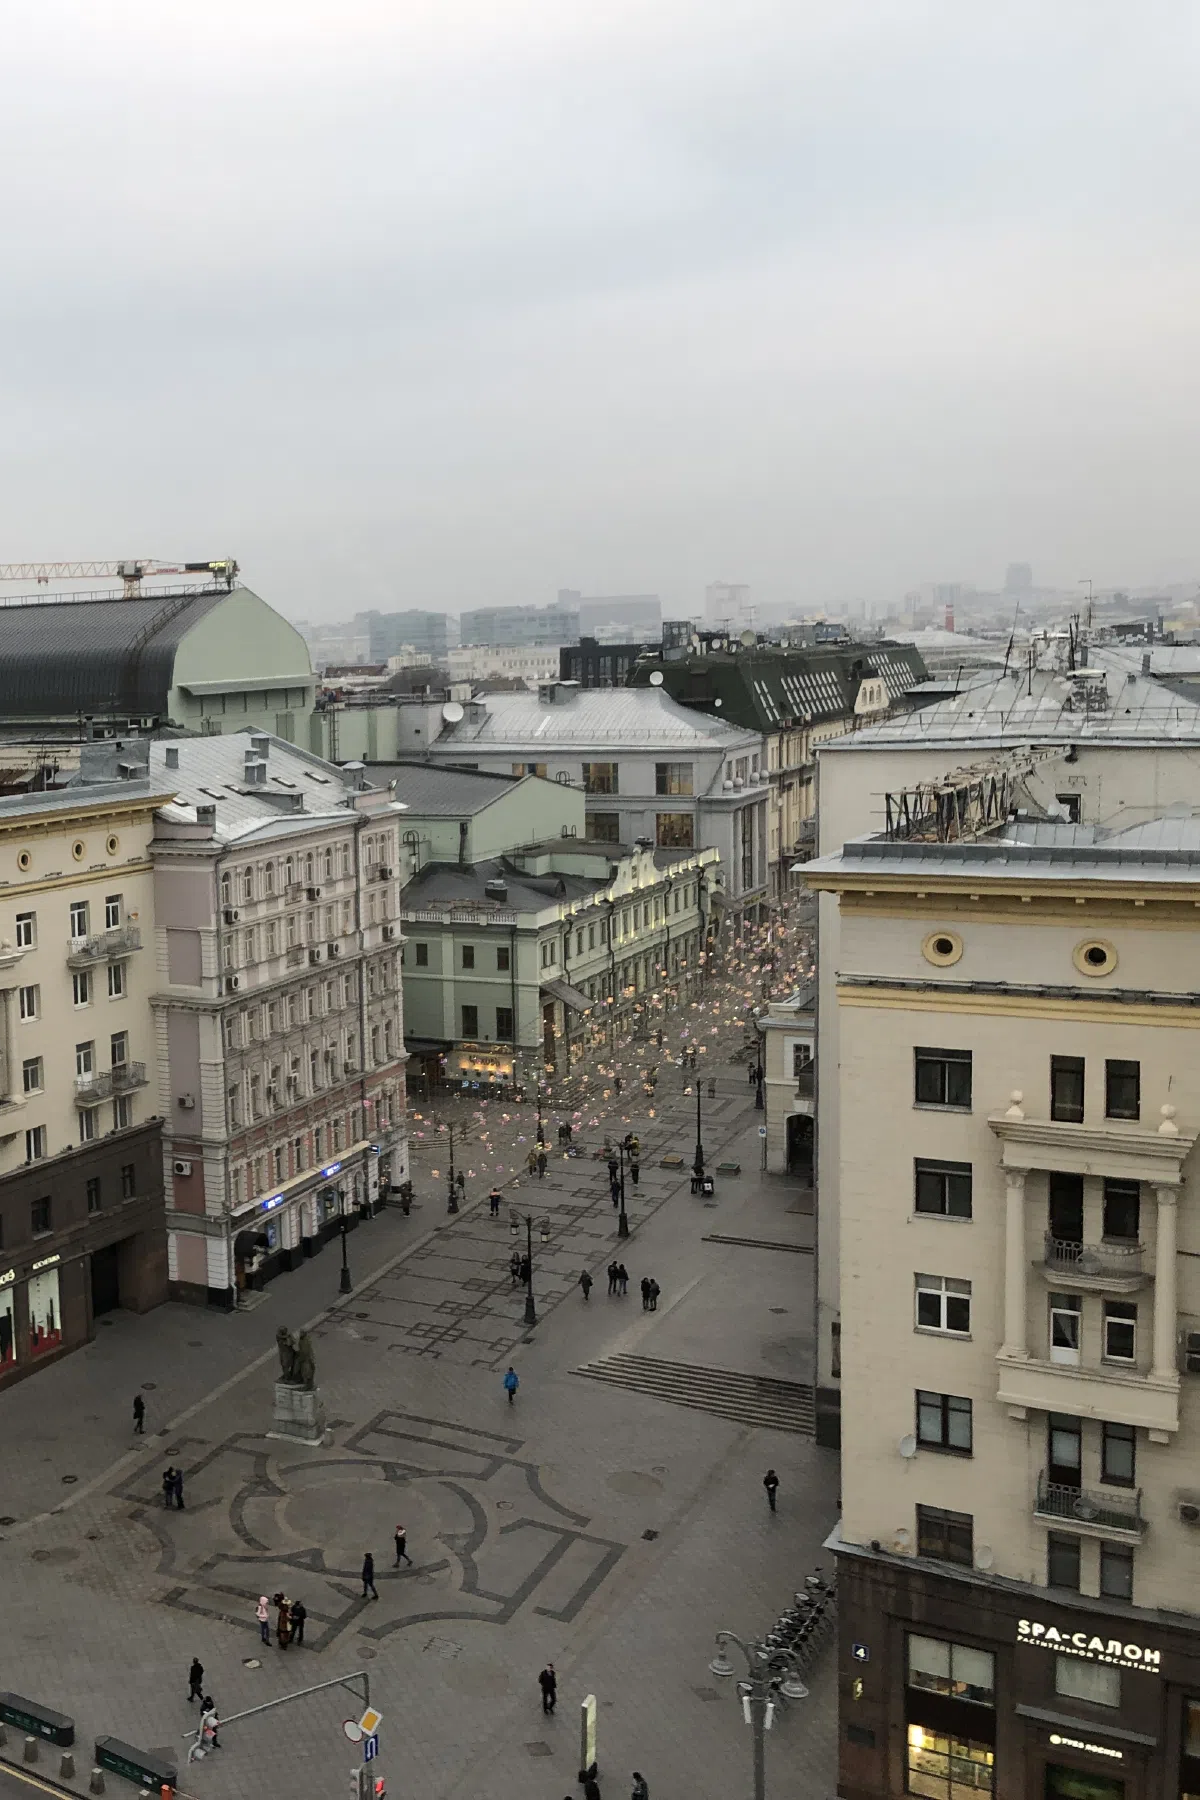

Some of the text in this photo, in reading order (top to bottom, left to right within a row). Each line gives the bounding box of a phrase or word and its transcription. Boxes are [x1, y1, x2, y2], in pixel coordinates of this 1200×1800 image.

[856, 1648, 866, 1658] 4
[1016, 1635, 1160, 1673] РАСТИТЕЛЬНОЙ КОСМЕТИКИ
[1018, 1619, 1161, 1664] SPA-САЛОН
